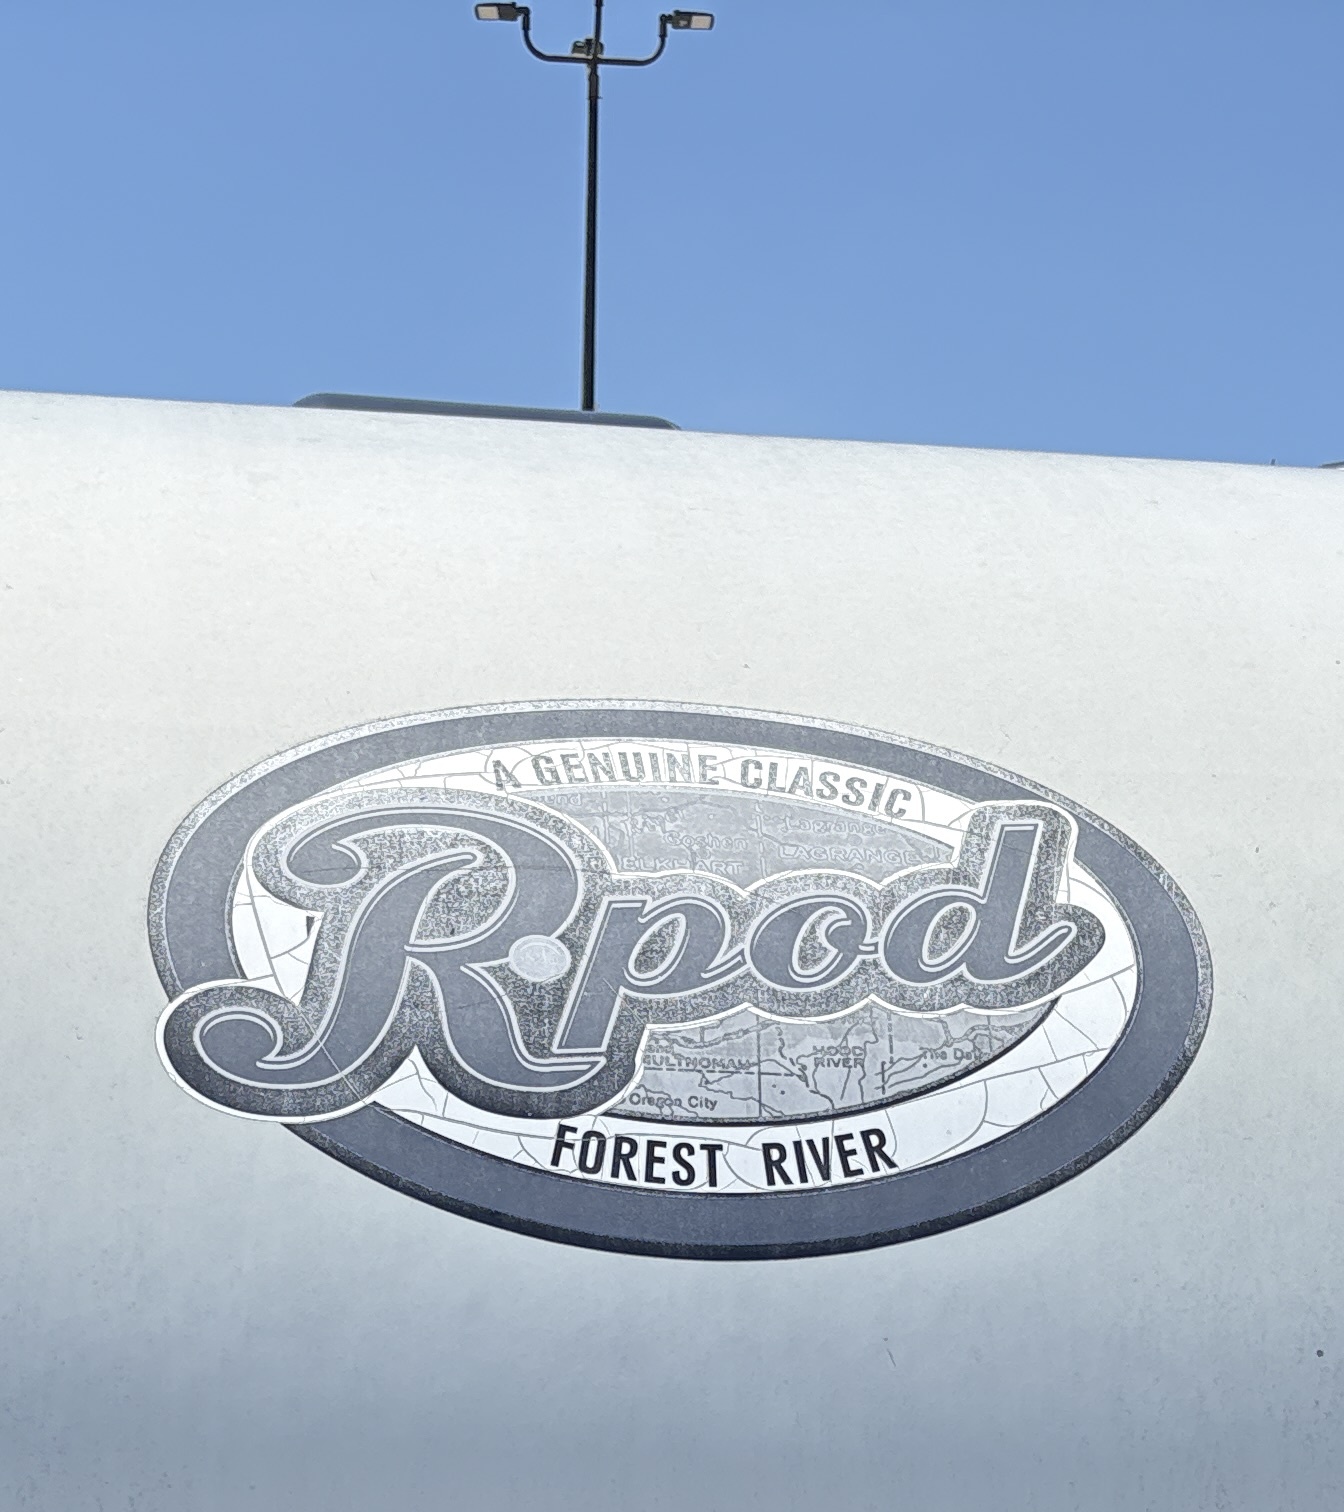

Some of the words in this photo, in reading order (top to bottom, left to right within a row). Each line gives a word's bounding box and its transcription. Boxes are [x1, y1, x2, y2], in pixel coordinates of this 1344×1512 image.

[492, 759, 522, 791] A
[531, 751, 720, 786] GENUINE
[740, 758, 912, 819] CLASSIC
[665, 832, 748, 850] Goshen
[622, 857, 744, 875] ELKHART
[813, 1057, 865, 1069] RIVER
[629, 1093, 683, 1108] Oregon
[688, 1095, 718, 1111] City
[551, 1123, 723, 1187] FOREST
[762, 1127, 899, 1187] RIVER
